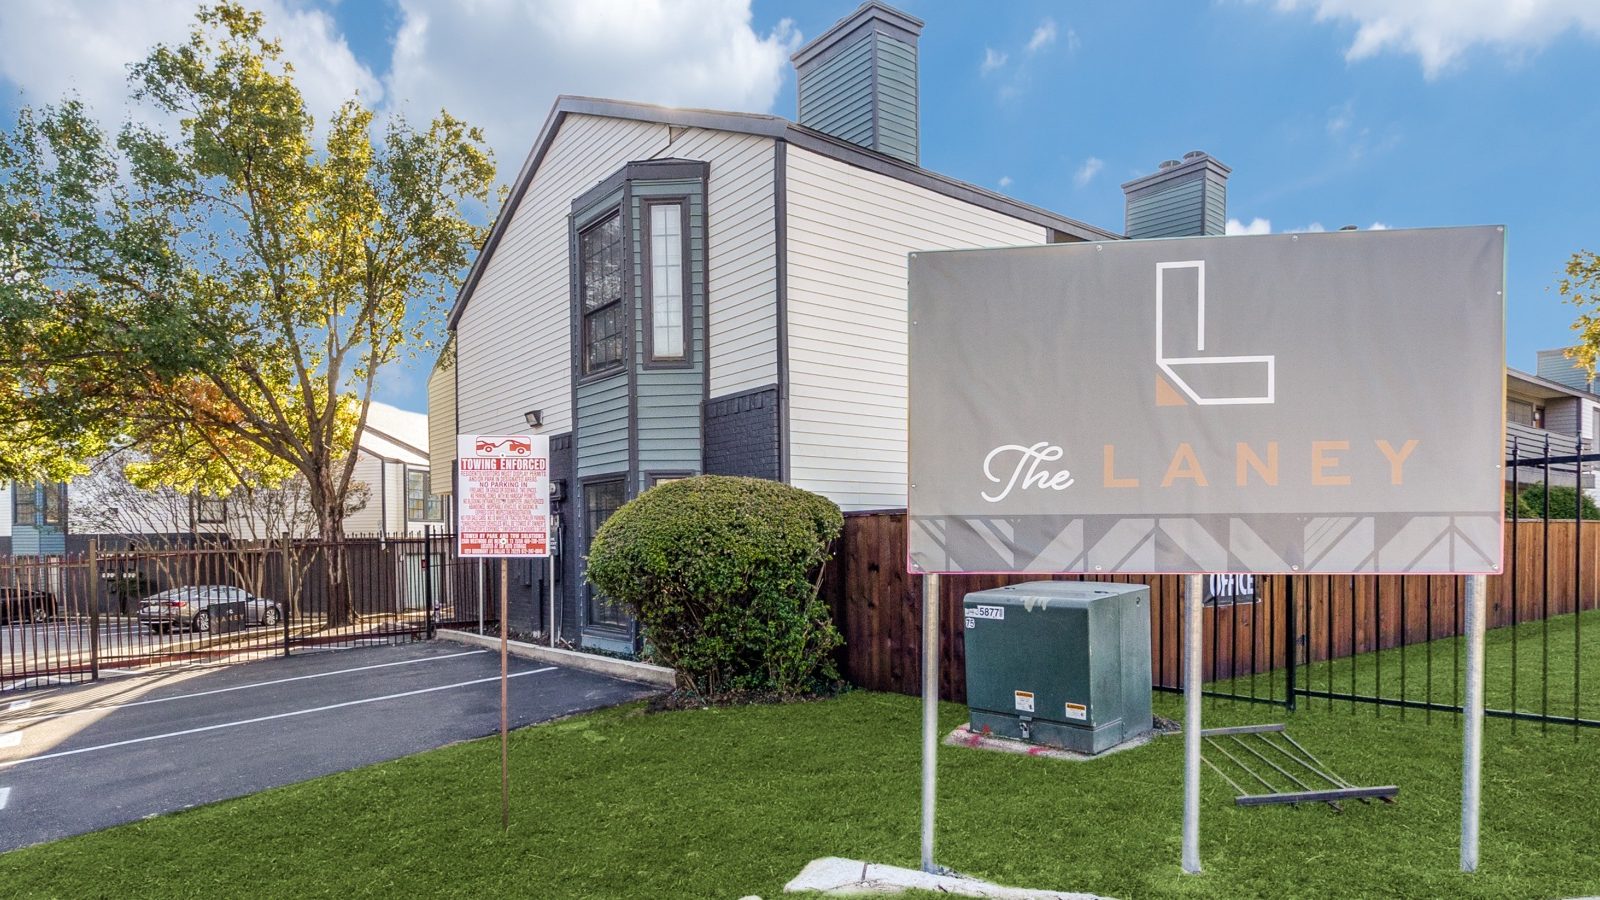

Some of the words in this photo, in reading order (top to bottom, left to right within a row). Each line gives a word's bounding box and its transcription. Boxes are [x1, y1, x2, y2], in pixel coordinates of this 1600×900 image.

[462, 459, 497, 470] TOWING
[500, 459, 546, 470] ENFORCED
[980, 441, 1074, 503] The
[1103, 439, 1420, 489] LANEY
[1209, 574, 1254, 597] OFFICE
